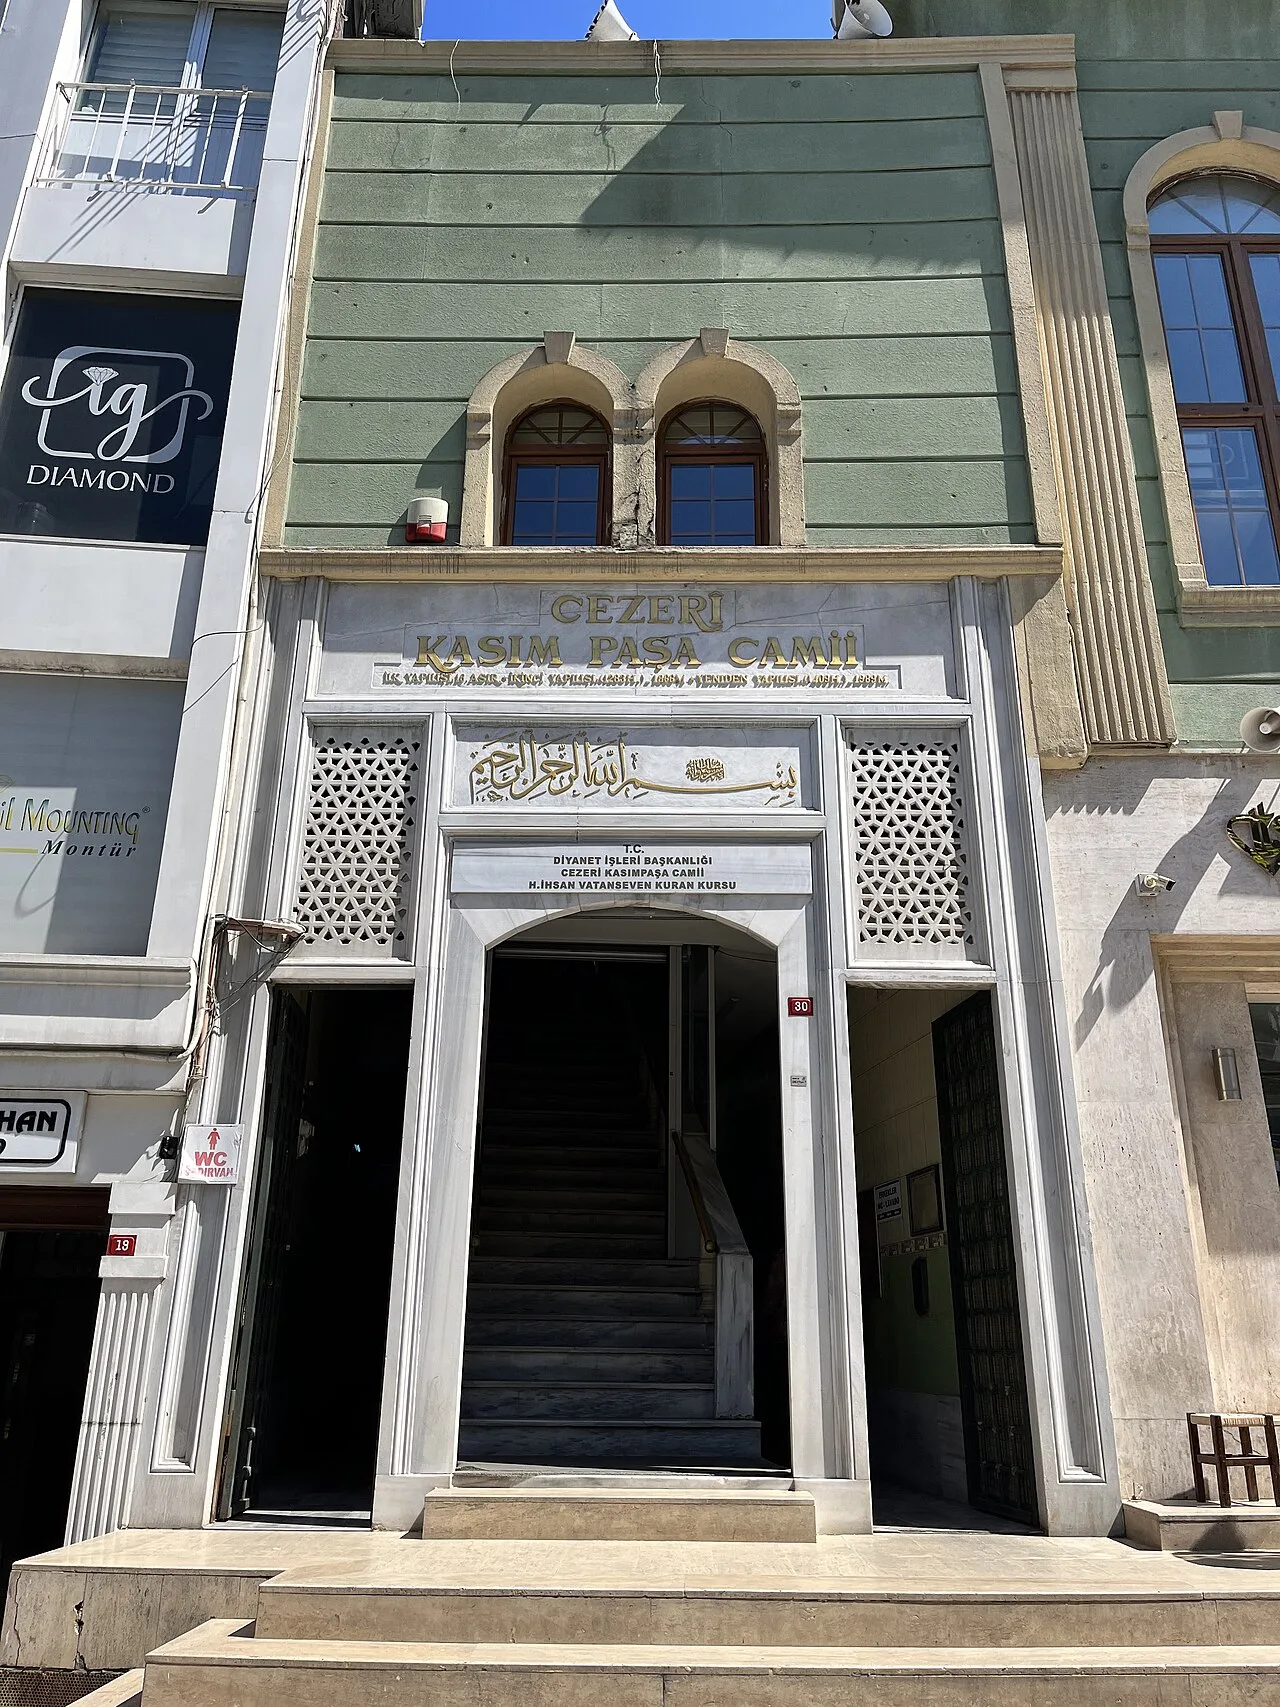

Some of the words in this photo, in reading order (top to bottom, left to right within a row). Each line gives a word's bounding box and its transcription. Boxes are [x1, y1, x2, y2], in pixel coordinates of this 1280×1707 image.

[26, 464, 175, 494] DIAMOND
[413, 635, 564, 673] KASIM
[587, 636, 702, 673] PAŞA
[728, 630, 859, 669] CAMİİ
[41, 839, 137, 857] Montür
[622, 844, 645, 854] T.C.
[553, 855, 602, 865] DİYANET
[604, 854, 641, 867] İŞLERİ
[644, 854, 713, 867] BAŞKANLIĞI
[561, 867, 601, 877] CEZERİ
[604, 868, 669, 879] KASIMPAŞA
[672, 867, 705, 877] CAMİİ
[528, 879, 576, 890] H.İHSAN
[578, 881, 652, 890] VATANSEVEN
[655, 881, 695, 890] KURAN
[698, 881, 737, 890] KURSU
[794, 1001, 808, 1012] 30
[194, 1151, 228, 1167] WC
